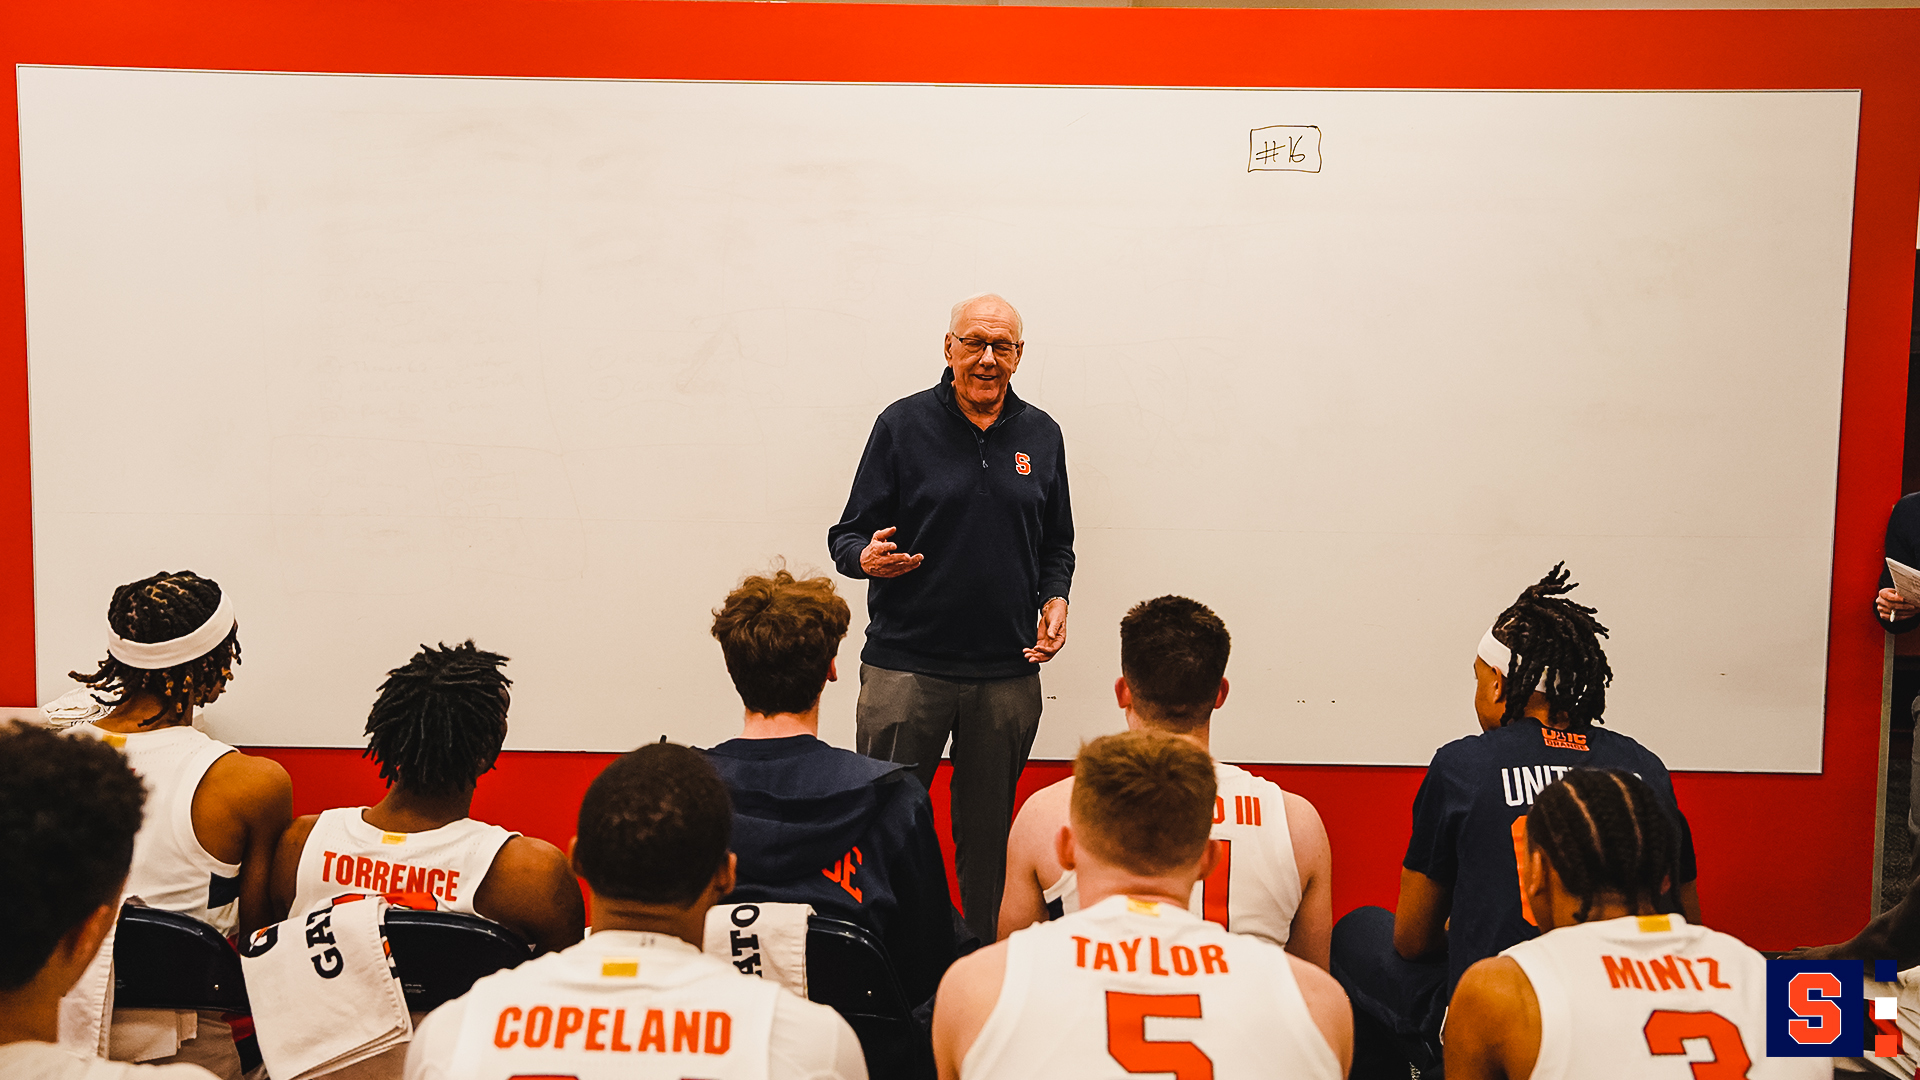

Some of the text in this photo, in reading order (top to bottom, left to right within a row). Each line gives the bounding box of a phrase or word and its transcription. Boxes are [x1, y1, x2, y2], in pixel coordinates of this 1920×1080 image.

[1256, 134, 1306, 165] #16
[1015, 452, 1031, 475] S
[1235, 795, 1262, 827] III
[322, 850, 461, 902] TORRENCE
[1071, 935, 1229, 977] TAYLOR
[1601, 954, 1732, 992] MINTZ
[493, 1005, 732, 1055] COPELAND
[1105, 990, 1215, 1080] 5
